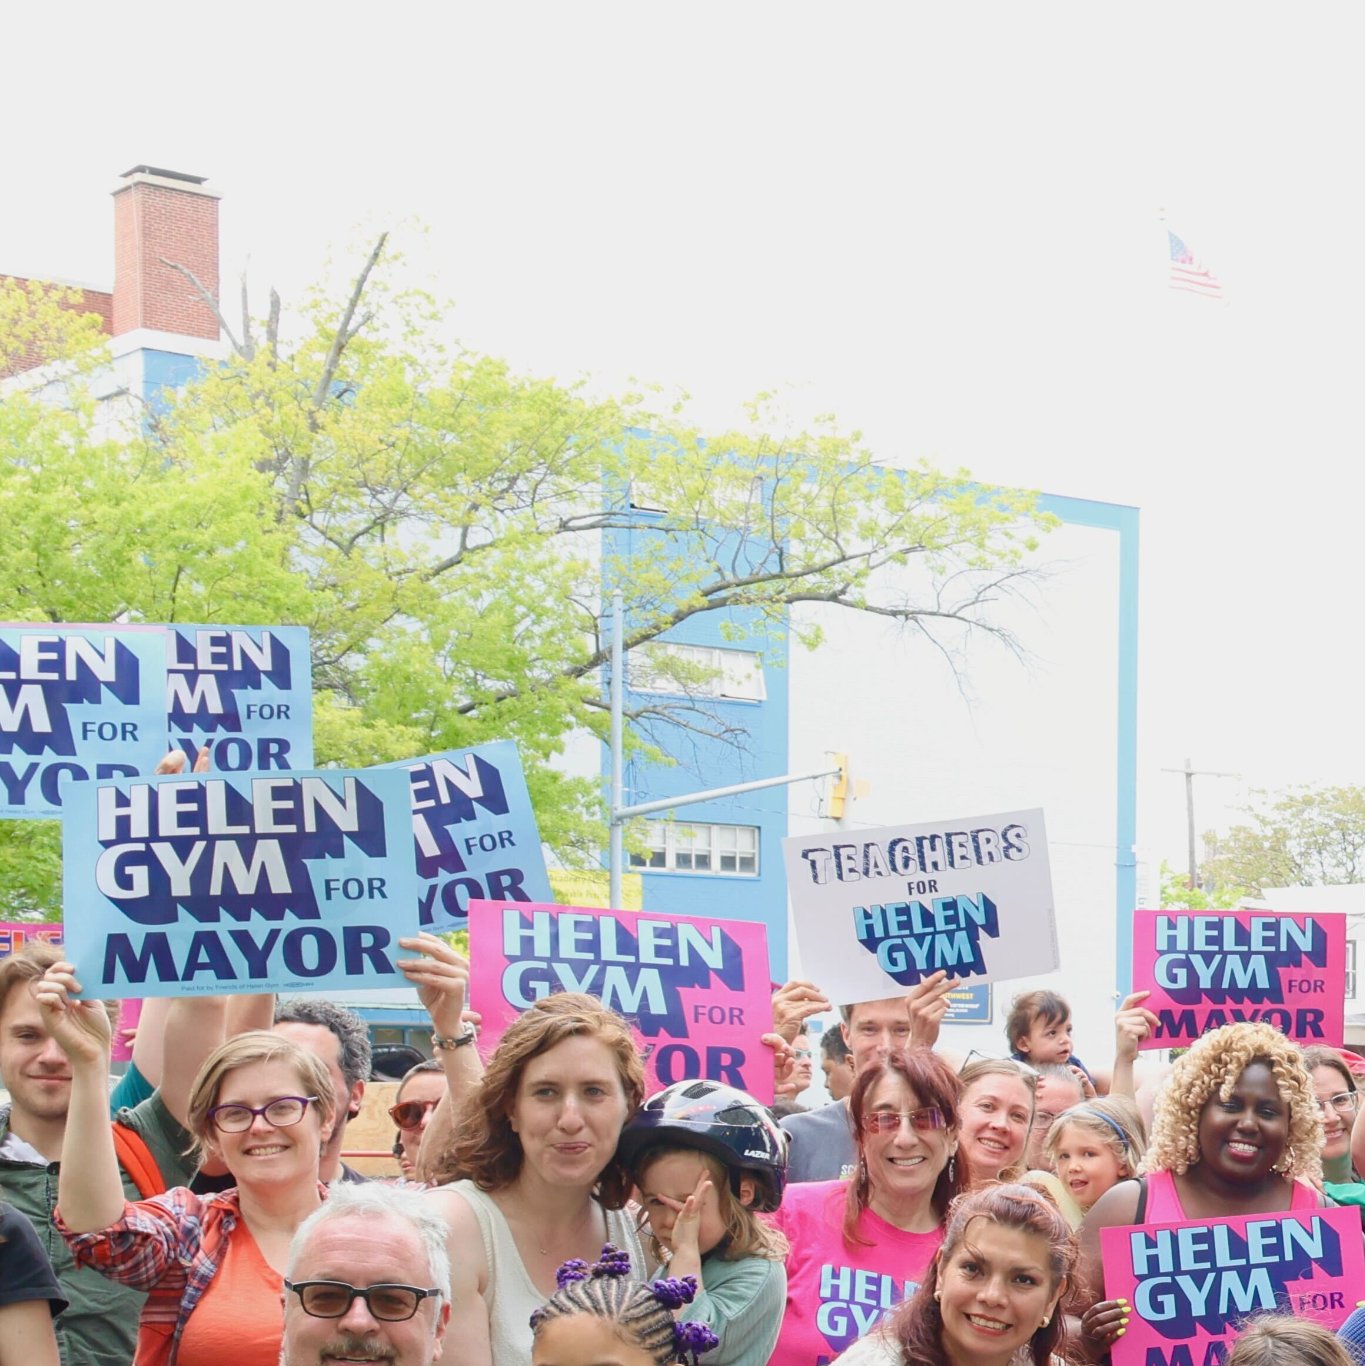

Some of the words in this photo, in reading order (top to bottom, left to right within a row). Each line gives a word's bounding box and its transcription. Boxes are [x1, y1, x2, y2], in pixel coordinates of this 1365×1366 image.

[168, 629, 272, 671] LEN
[82, 722, 139, 741] FOR
[246, 704, 291, 719] FOR
[169, 738, 291, 771] YOR
[98, 777, 359, 840] HELEN
[465, 830, 515, 855] FOR
[802, 824, 1030, 884] TEACHERS
[96, 839, 292, 899] GYM
[325, 877, 388, 900] FOR
[907, 880, 938, 896] FOR
[419, 868, 532, 925] YOR
[853, 892, 986, 939] HELEN
[102, 926, 395, 984] MAYOR
[502, 910, 723, 969] HELEN
[877, 930, 974, 973] GYM
[1156, 916, 1312, 951] HELEN
[501, 961, 668, 1014] GYM
[694, 1005, 745, 1025] FOR
[1154, 953, 1270, 989] GYM
[1288, 979, 1324, 993] FOR
[744, 1149, 770, 1160] LAZER
[1130, 1216, 1323, 1275] HELEN
[1134, 1268, 1277, 1321] GYM
[1300, 1292, 1344, 1310] FOR
[816, 1301, 893, 1339] GY
